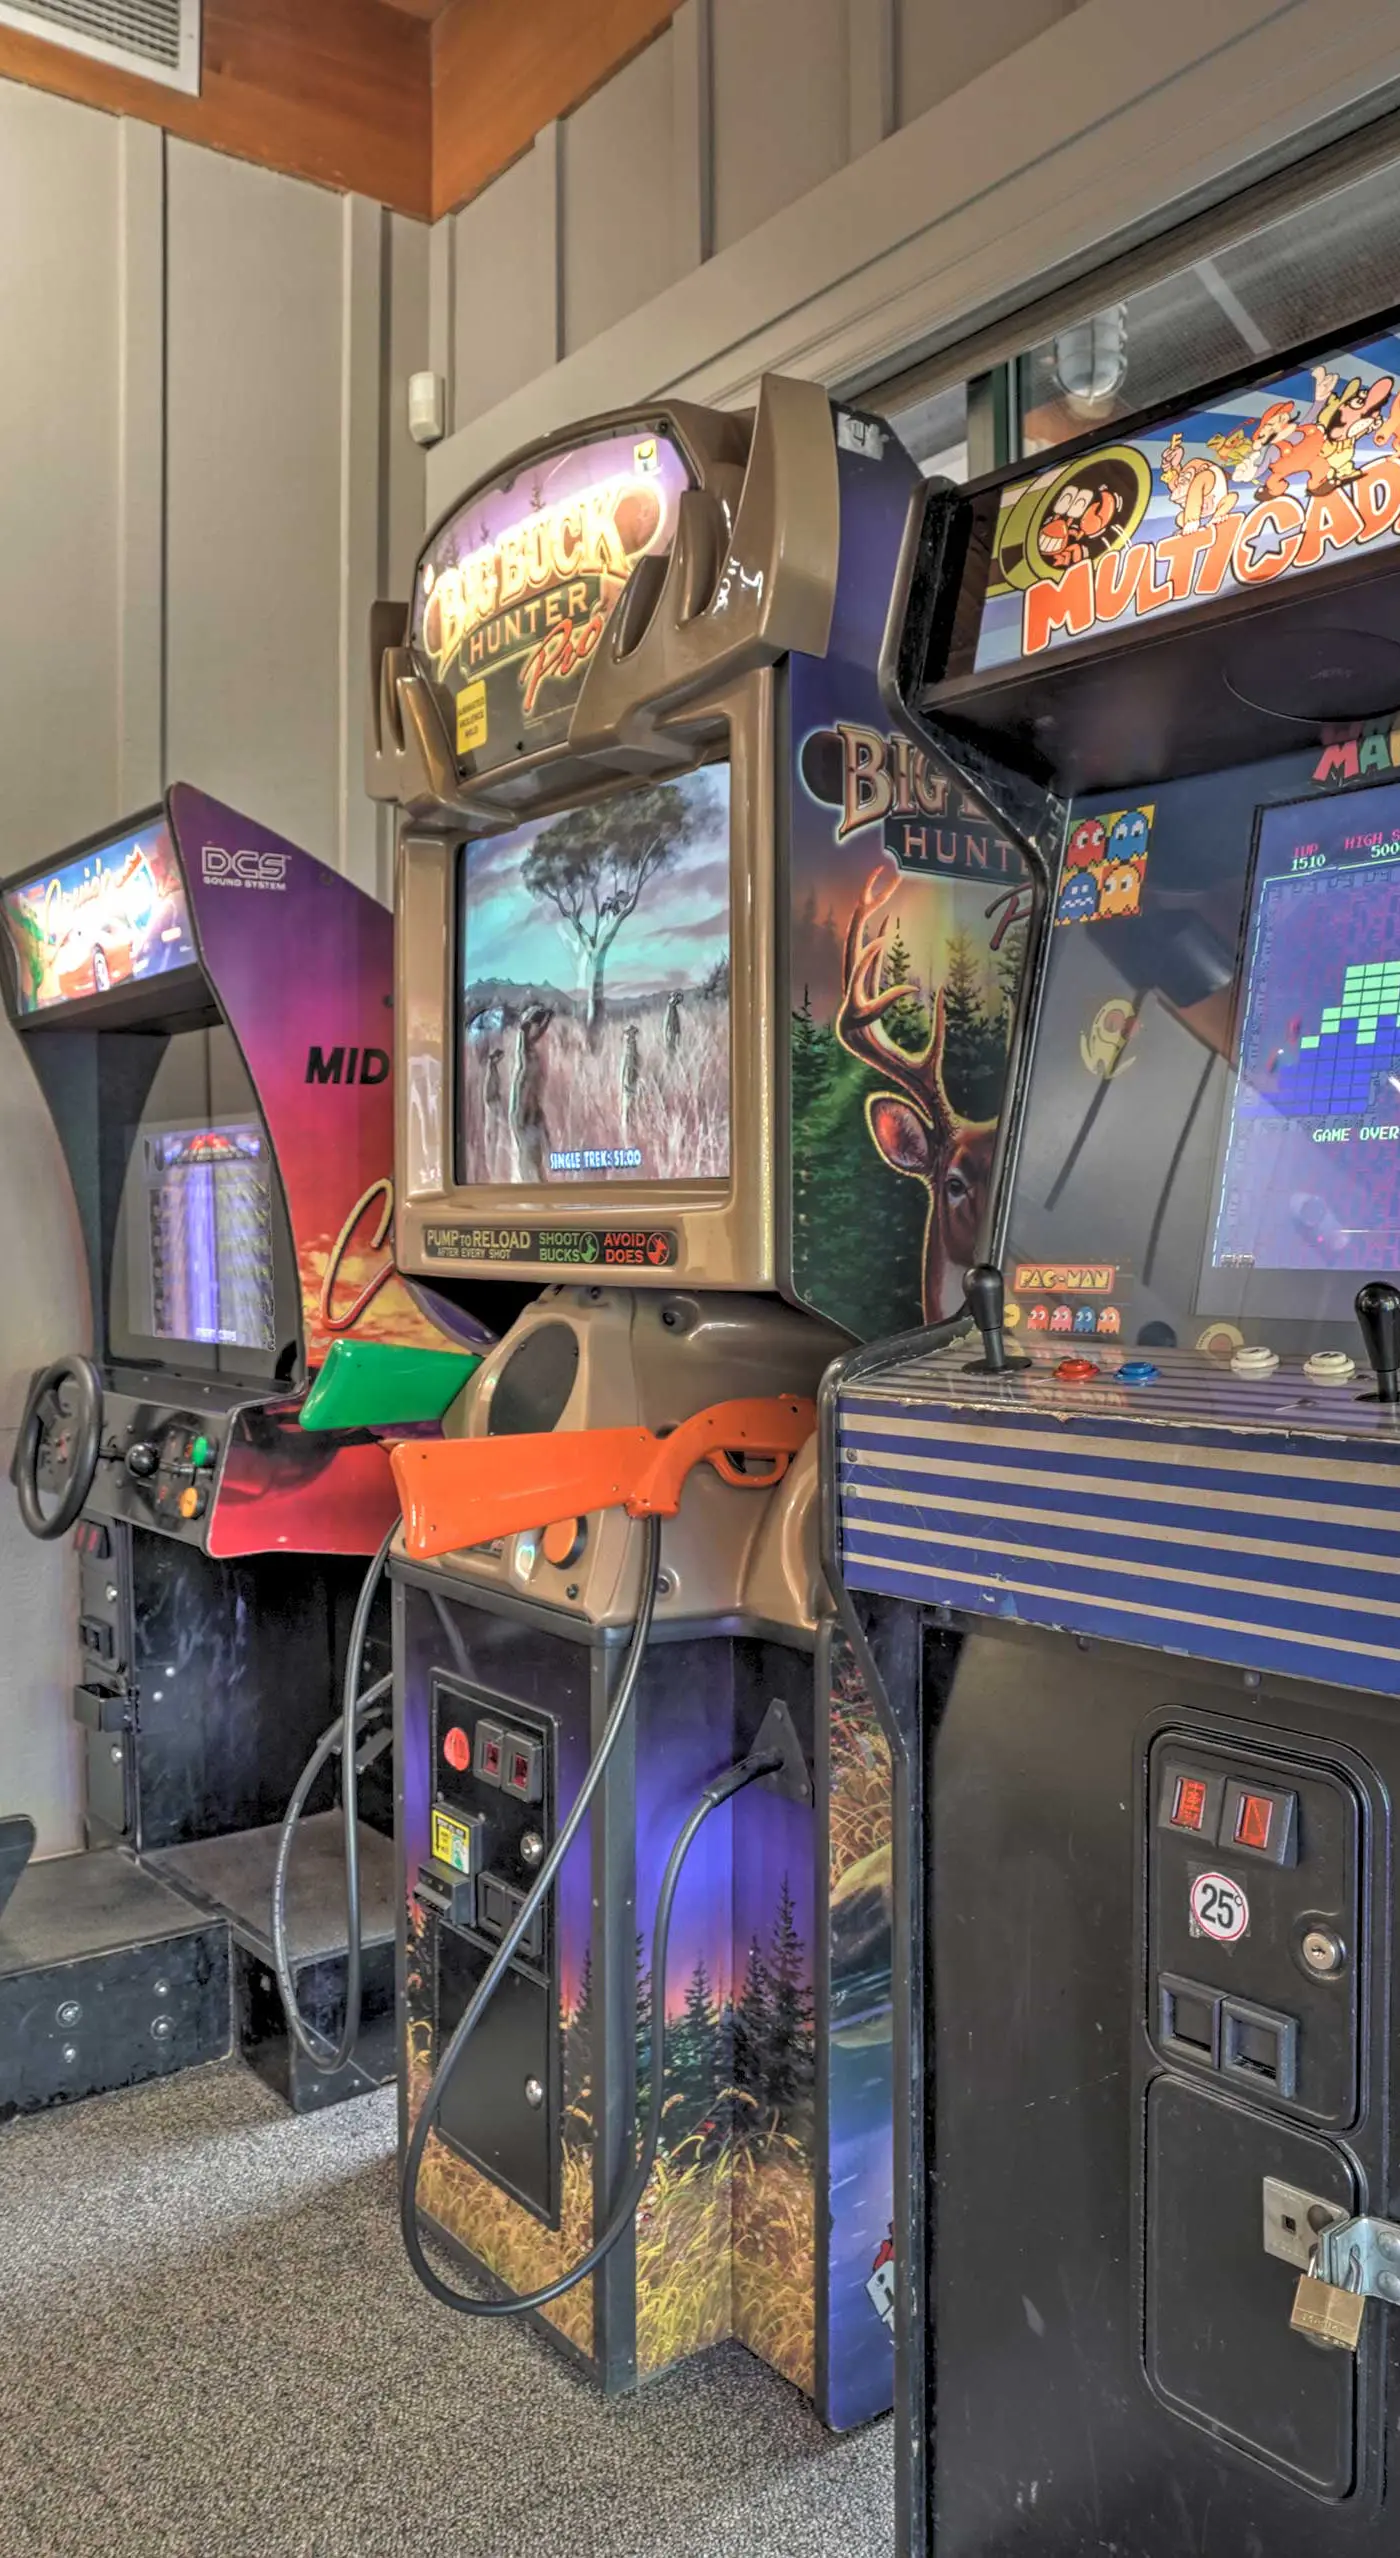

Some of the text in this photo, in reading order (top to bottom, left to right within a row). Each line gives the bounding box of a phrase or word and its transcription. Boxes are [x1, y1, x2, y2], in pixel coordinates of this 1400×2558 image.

[1022, 457, 1400, 657] MULTICAD
[434, 484, 633, 682] BIG BUCK
[469, 582, 589, 666] HUNTER
[518, 614, 606, 714] Pro
[836, 721, 949, 842] BIG
[1294, 843, 1319, 859] 1UP
[1343, 831, 1384, 850] HIGH
[1291, 853, 1326, 871] 1510
[202, 876, 287, 891] SOUND SYSTEM
[1312, 1126, 1400, 1143] GAME OVER
[550, 1151, 581, 1169] SINGLE
[613, 1149, 642, 1167] $1.00
[427, 1230, 459, 1248] PUMP
[472, 1231, 531, 1249] RELOAD
[539, 1232, 580, 1246] SHOOT
[603, 1232, 647, 1247] AVOID
[437, 1247, 511, 1260] AFTER EVERY SHOT
[539, 1247, 580, 1263] BUCKS
[605, 1248, 644, 1264] DOES
[1019, 1270, 1112, 1290] PAC-MAN
